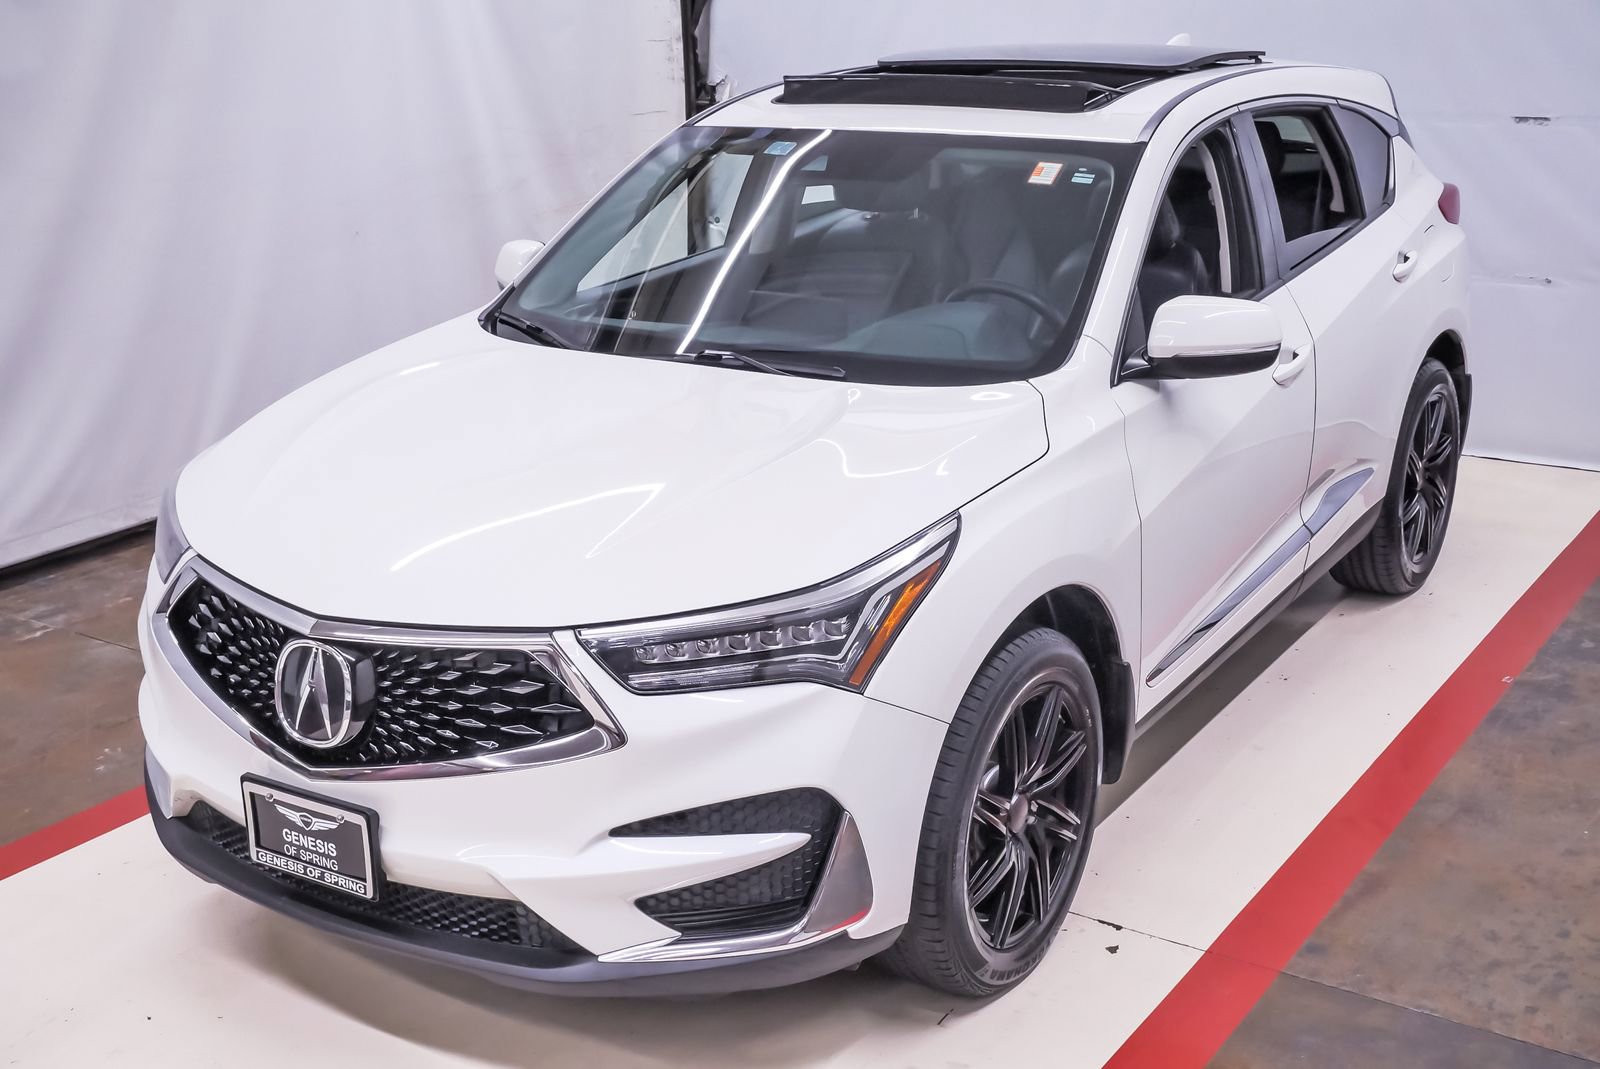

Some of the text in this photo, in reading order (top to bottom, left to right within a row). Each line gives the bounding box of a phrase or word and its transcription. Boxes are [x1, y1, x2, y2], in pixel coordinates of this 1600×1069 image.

[282, 828, 337, 856] GENESIS
[284, 844, 338, 871] OF SPRING
[258, 852, 365, 894] GENESIS OF SPRING
